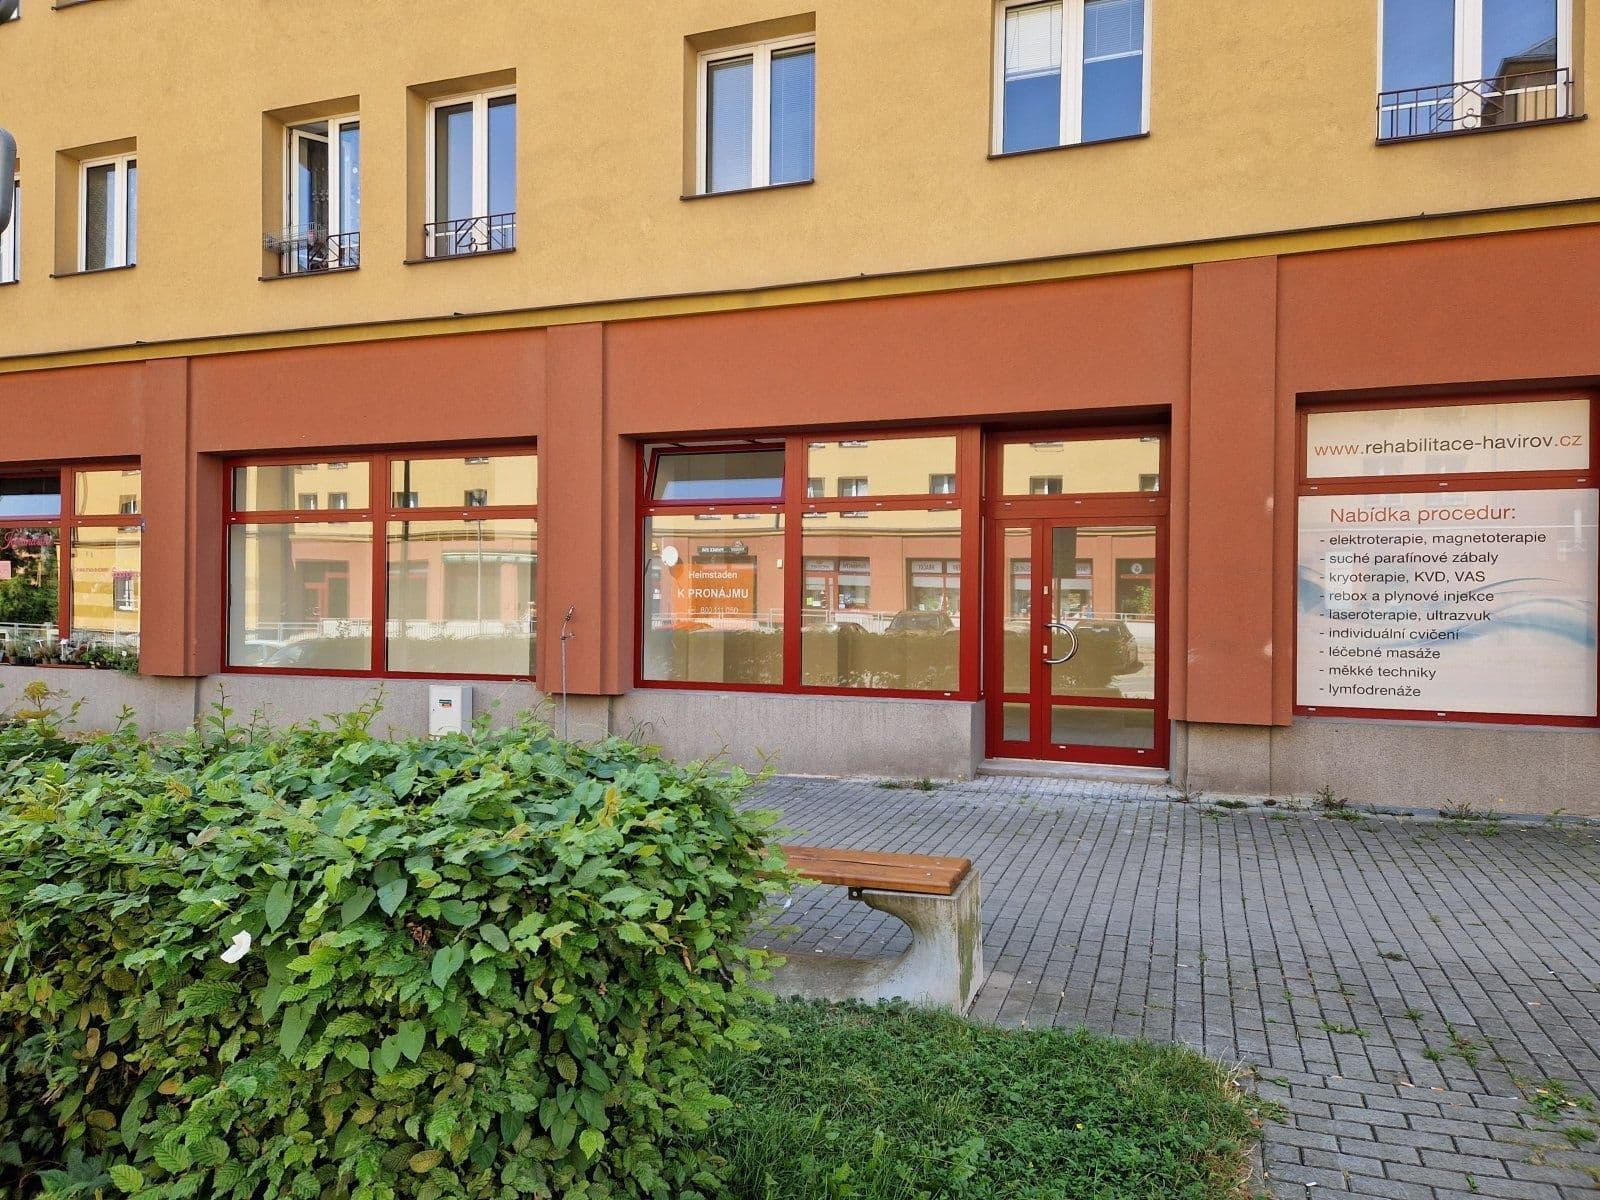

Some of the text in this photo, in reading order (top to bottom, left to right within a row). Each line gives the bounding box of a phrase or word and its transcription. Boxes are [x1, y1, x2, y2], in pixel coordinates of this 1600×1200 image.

[1314, 433, 1583, 456] www.rehabilitace-havirov.cz
[1330, 504, 1516, 524] Nabídka procedur:
[1329, 533, 1427, 547] elektroterapie,
[1432, 531, 1547, 547] magnetoterapie
[1329, 552, 1370, 564] suché
[1452, 551, 1499, 566] zábaly
[688, 570, 738, 580] Heimstaden
[1329, 571, 1409, 585] kryoterapie,
[1414, 570, 1450, 584] KVD,
[1454, 570, 1486, 583] VAS
[677, 586, 749, 599] K PRONÁJMU
[1329, 590, 1368, 602] rebox
[1371, 592, 1381, 602] a
[1384, 590, 1440, 604] plynové
[1443, 590, 1495, 604] injekce
[1329, 608, 1422, 623] laseroterapie,
[1427, 609, 1491, 621] ultrazvuk
[1329, 627, 1406, 640] individuální
[1409, 628, 1461, 641] cvičení
[1328, 645, 1382, 658] léčebné
[1386, 647, 1441, 660] masáže
[1328, 664, 1373, 678] měkké
[1377, 666, 1437, 681] techniky
[1328, 683, 1421, 697] lymfodrenáže
